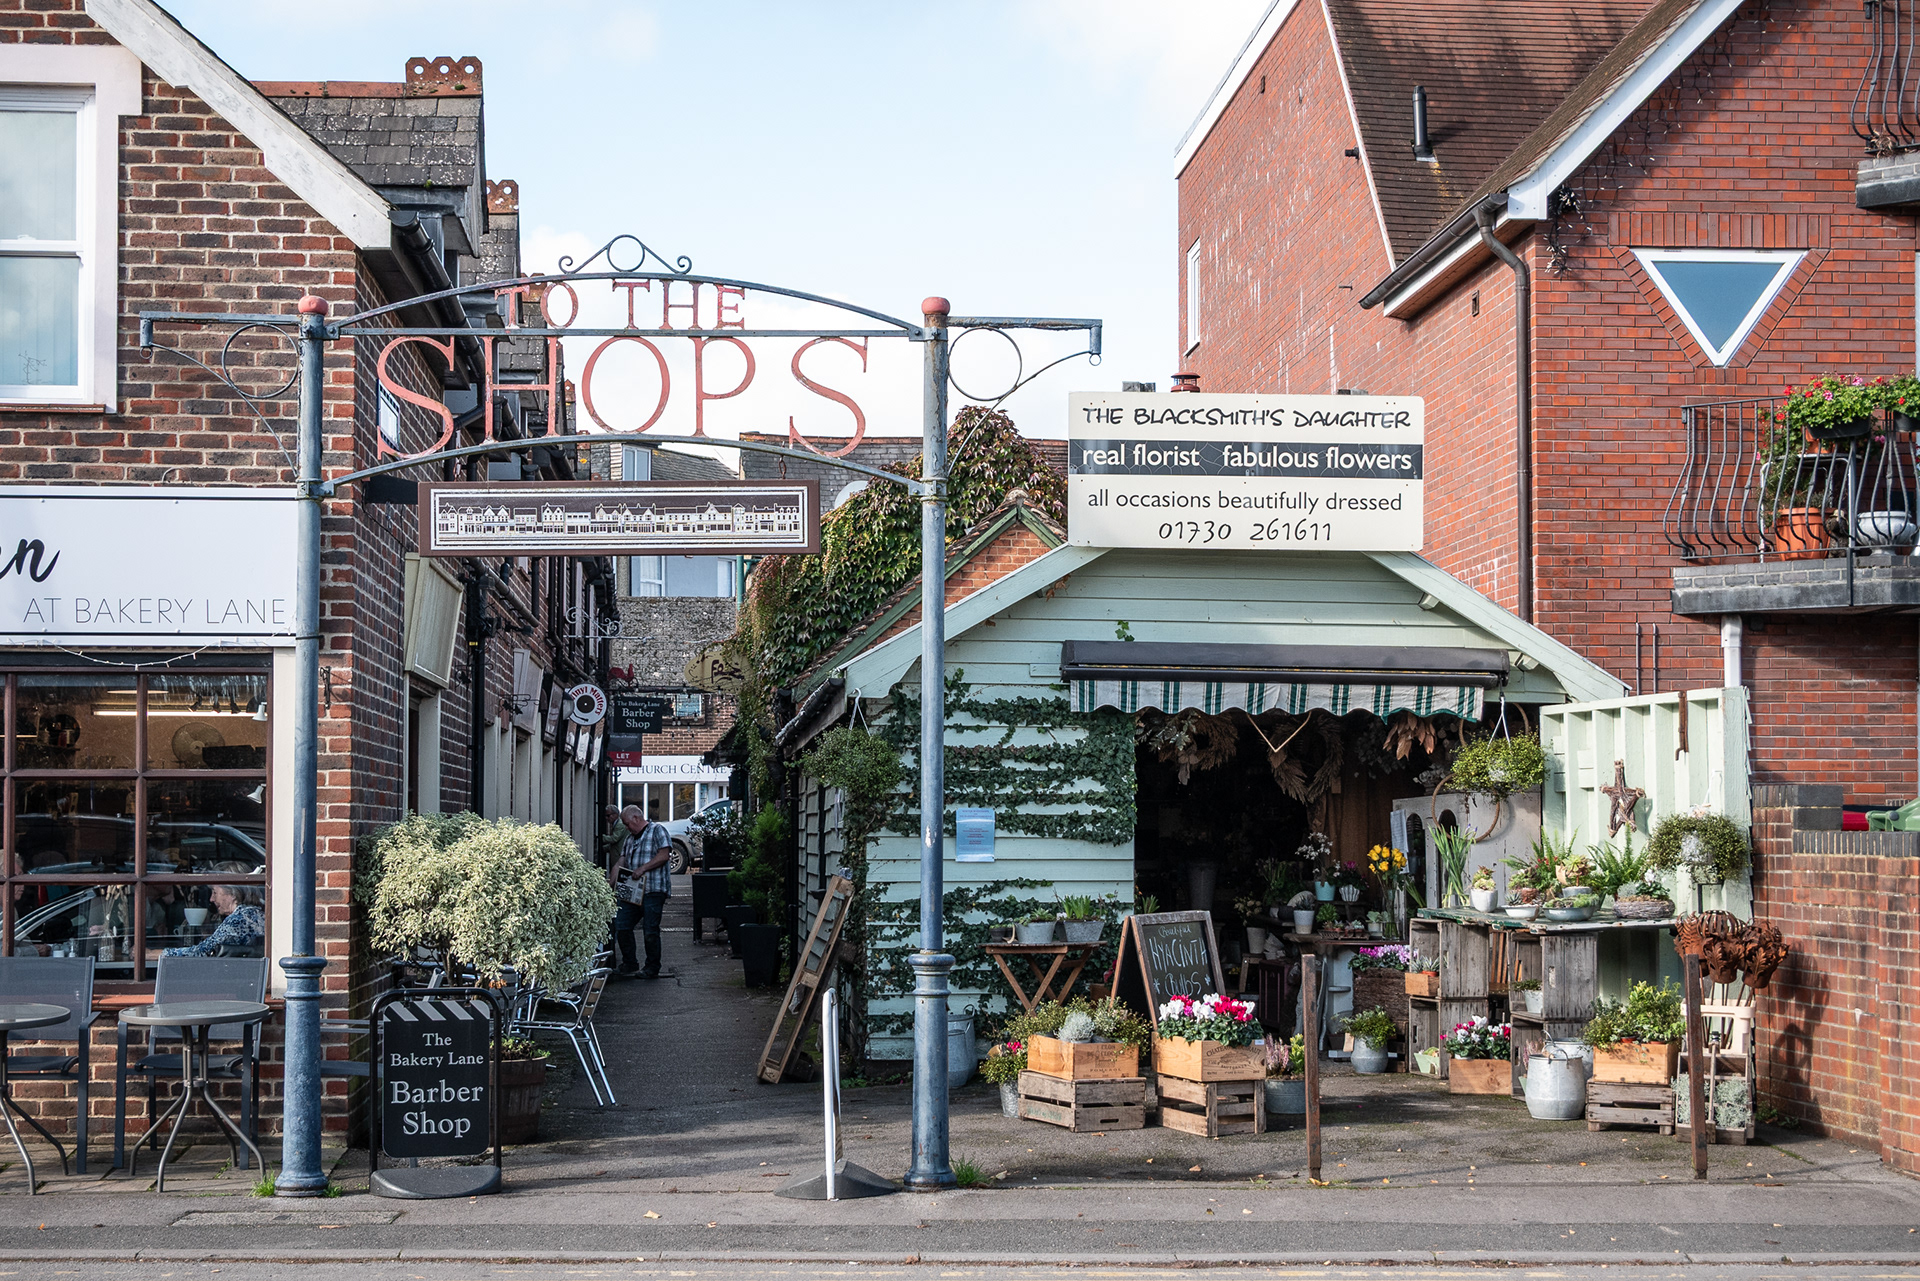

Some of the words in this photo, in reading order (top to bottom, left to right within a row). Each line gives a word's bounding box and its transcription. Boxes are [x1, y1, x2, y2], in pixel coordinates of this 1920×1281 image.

[495, 280, 578, 329] TO
[612, 280, 746, 330] THE
[377, 336, 868, 460] SHOPS
[1083, 407, 1124, 425] THE
[1134, 407, 1284, 428] BLACKSMITH'S
[1294, 410, 1412, 429] DAUGHTER
[1083, 443, 1125, 466] real
[1133, 443, 1200, 467] florist
[1223, 444, 1319, 469] fabulous
[1326, 446, 1413, 471] flowers
[1088, 488, 1109, 507] all
[1116, 490, 1211, 509] occasions
[1218, 490, 1320, 515] beautifully
[1326, 492, 1402, 511] dressed
[1158, 520, 1233, 544] 01730
[1249, 518, 1332, 542] 261611
[23, 598, 61, 624] AT
[76, 598, 194, 624] BAKERY
[206, 598, 285, 625] LANE
[590, 687, 604, 716] Matters
[622, 708, 655, 718] Barber
[626, 718, 650, 729] Shop
[627, 763, 676, 774] CHURCH
[681, 763, 727, 774] CENTRE
[422, 1033, 452, 1046] The
[390, 1053, 443, 1068] Bakery
[448, 1052, 484, 1065] Lane
[390, 1079, 483, 1104] Barber
[403, 1111, 471, 1138] Shop
